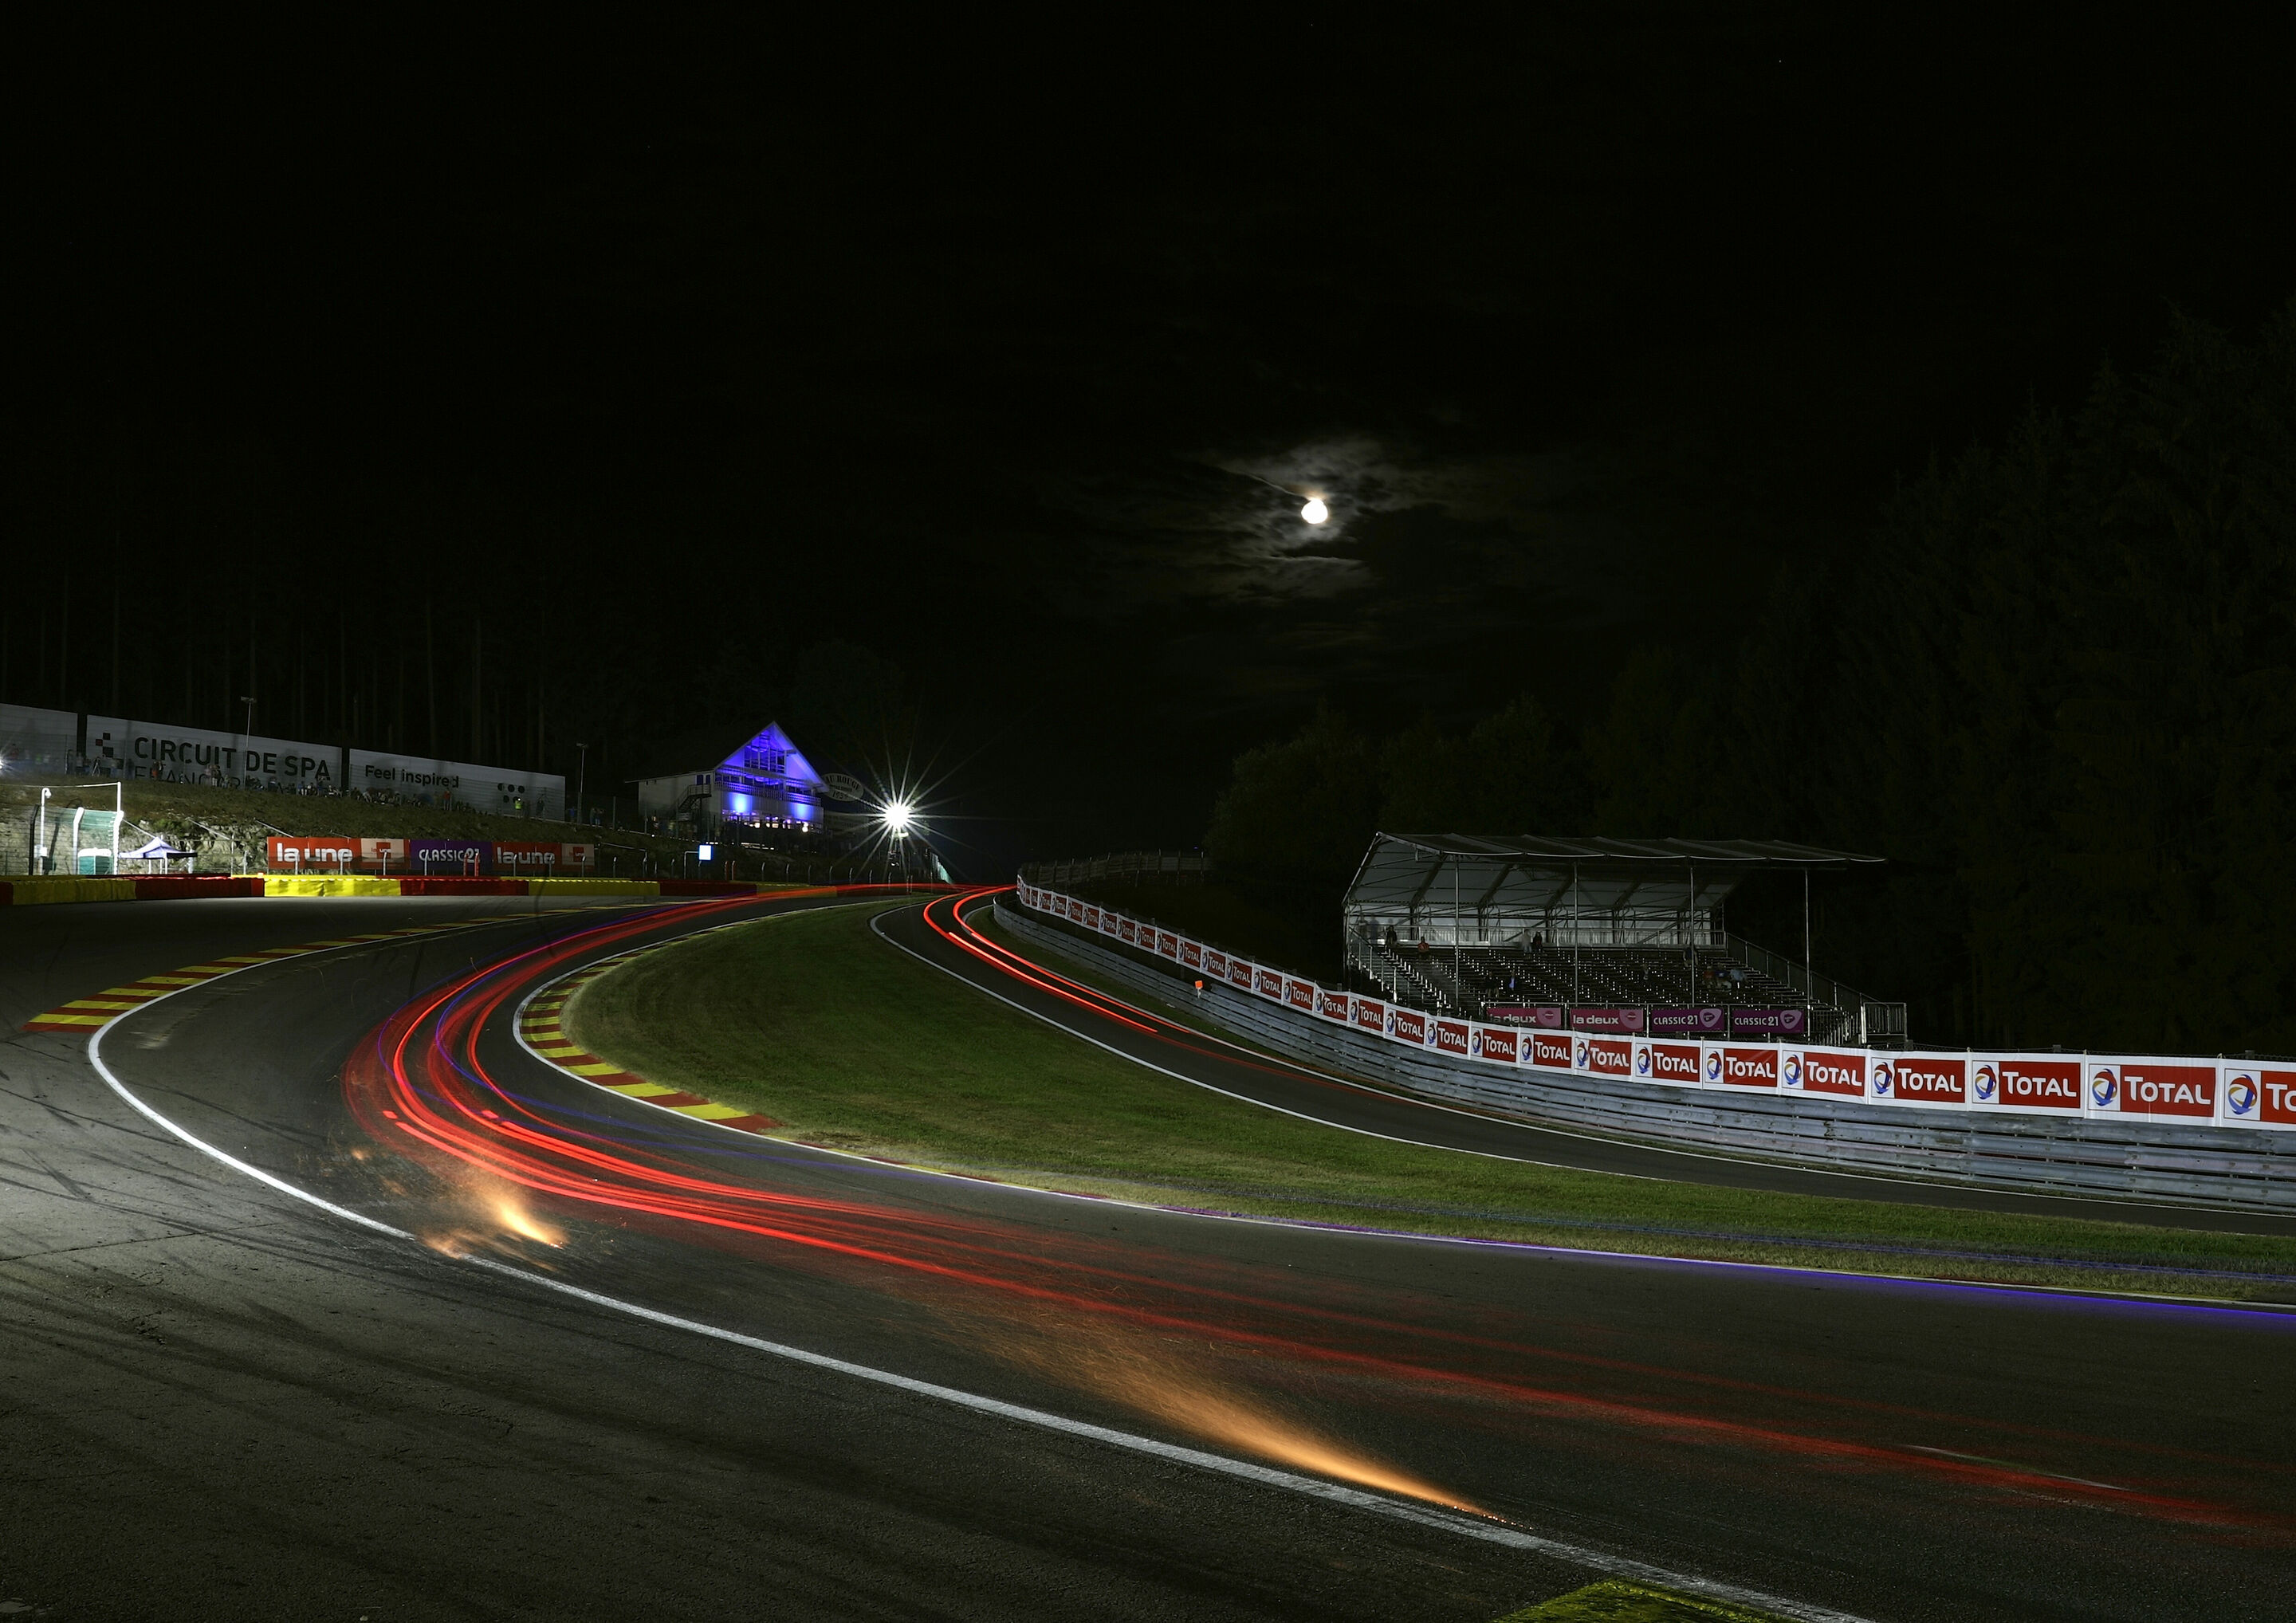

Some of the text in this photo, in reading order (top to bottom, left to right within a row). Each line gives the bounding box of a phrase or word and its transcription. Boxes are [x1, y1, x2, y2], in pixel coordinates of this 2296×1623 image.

[135, 737, 331, 780] CIRCUIT DE SPA
[365, 765, 459, 788] Feel inspired
[277, 843, 352, 862] la une
[419, 848, 466, 862] CLASSIC
[497, 847, 555, 864] la une
[1162, 937, 1176, 953] TOTAL
[1185, 945, 1199, 962] TOTAL
[1209, 957, 1224, 972] TOTAL
[1233, 966, 1251, 983] TOTAL
[1262, 976, 1281, 994] TOTAL
[1292, 986, 1311, 1004] TOTAL
[1324, 998, 1346, 1015] TOTAL
[1359, 1005, 1382, 1025] TOTAL
[1397, 1017, 1423, 1038] TOTAL
[1503, 1014, 1536, 1024] deux
[1573, 1015, 1619, 1024] la deux
[1653, 1016, 1686, 1025] CLASSIC
[1687, 1015, 1698, 1025] 21
[1734, 1017, 1767, 1026] CLASSIC
[1767, 1016, 1779, 1026] 21
[1437, 1028, 1467, 1047] TOTAL
[1484, 1035, 1515, 1055] TOTAL
[1535, 1042, 1570, 1060] TOTAL
[1590, 1047, 1630, 1067] TOTAL
[1654, 1052, 1698, 1074] TOTAL
[1726, 1057, 1775, 1078] TOTAL
[1806, 1061, 1862, 1087] TOTAL
[1897, 1068, 1962, 1092] TOTAL
[2002, 1071, 2077, 1097] TOTAL
[2125, 1076, 2211, 1105] TOTAL
